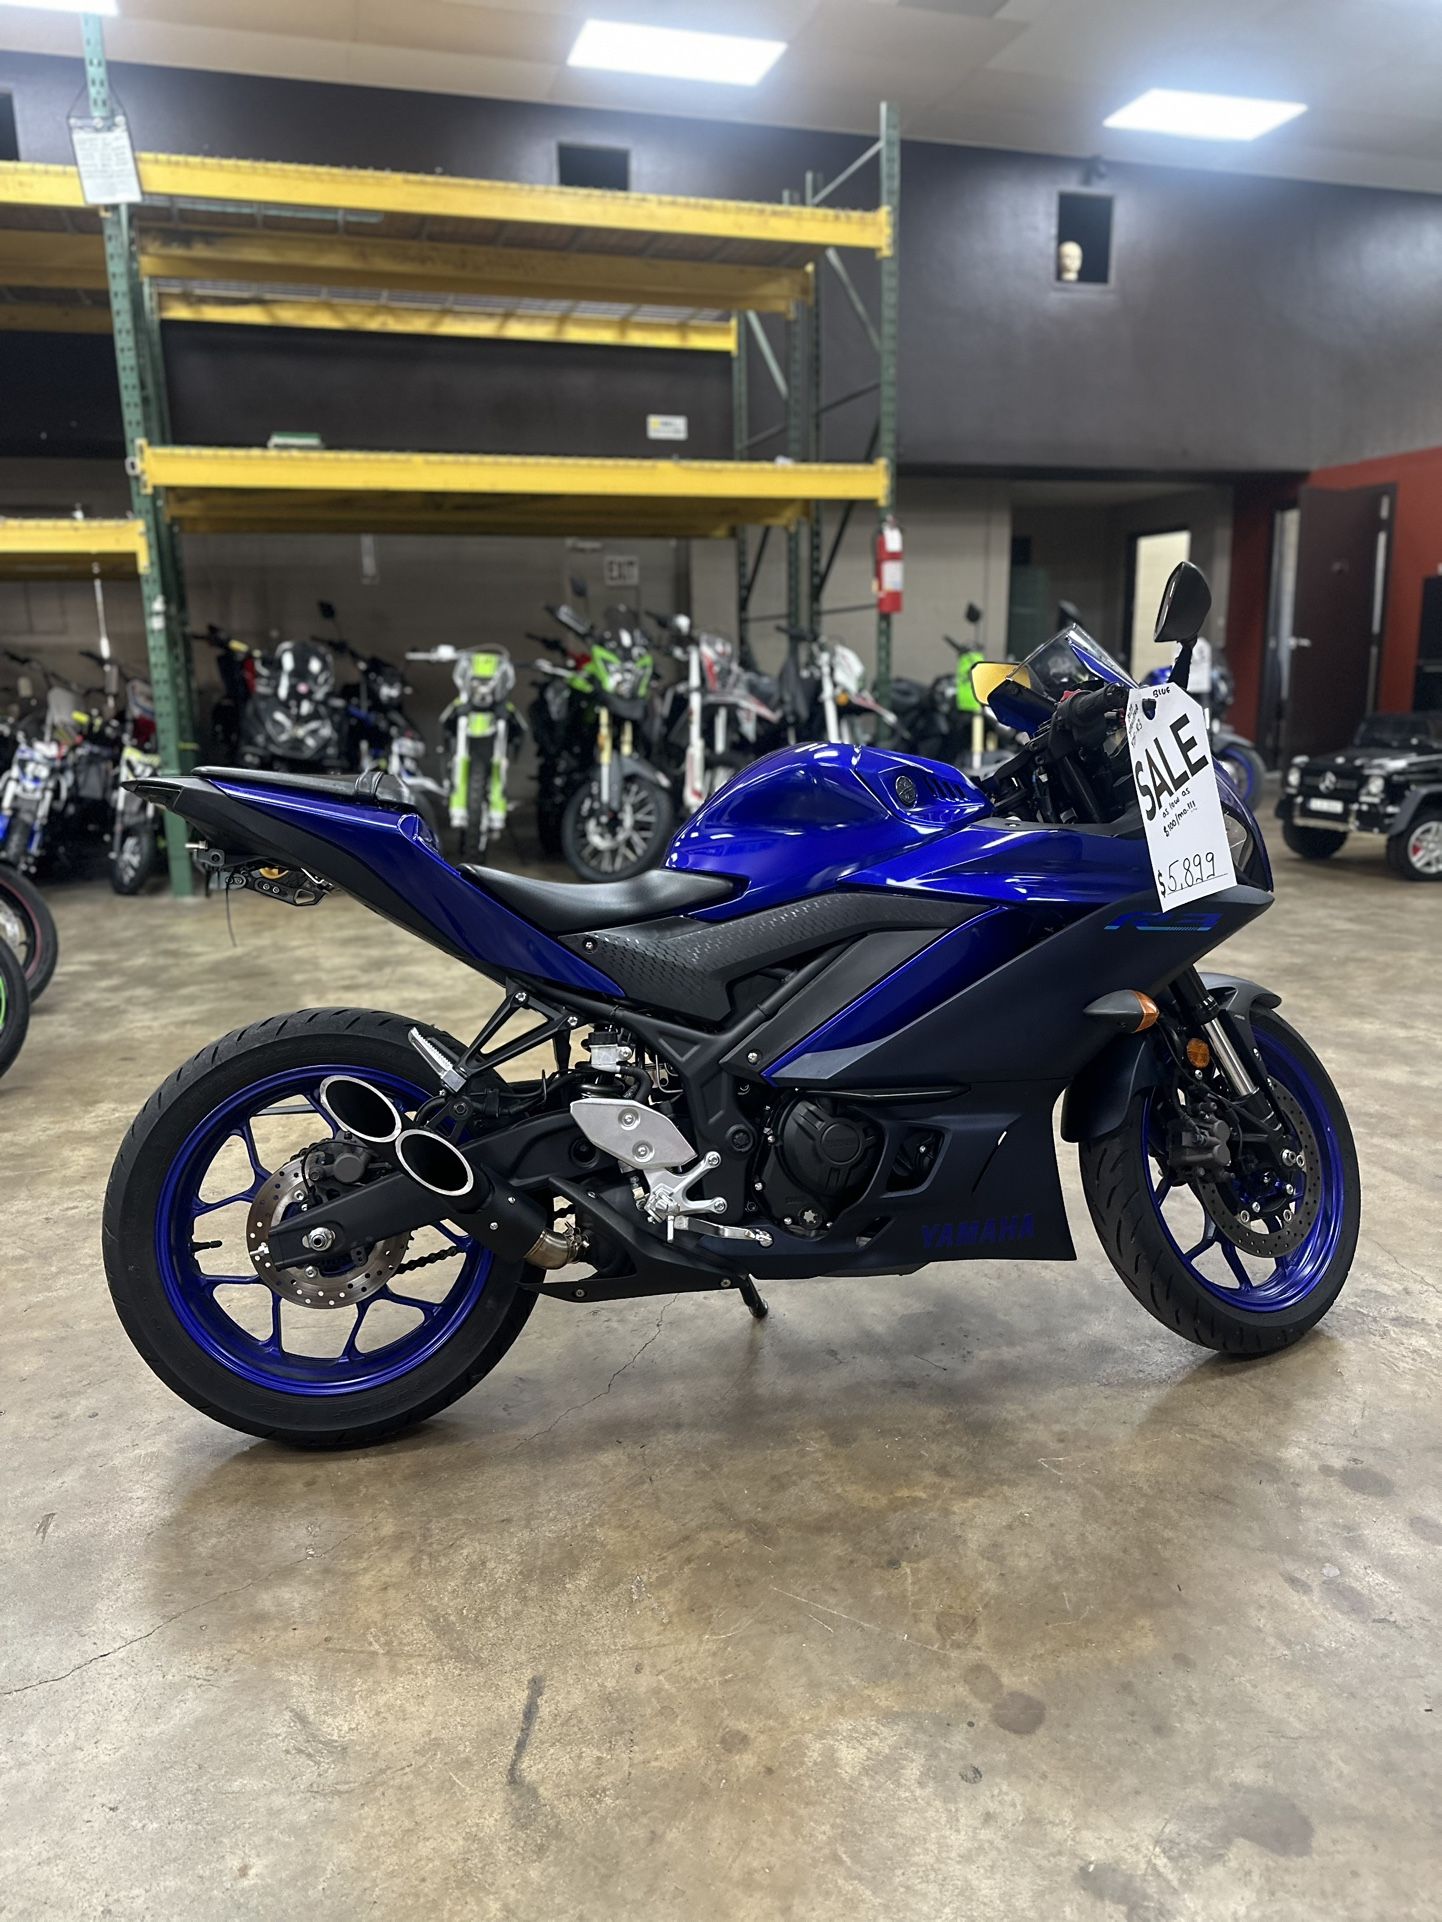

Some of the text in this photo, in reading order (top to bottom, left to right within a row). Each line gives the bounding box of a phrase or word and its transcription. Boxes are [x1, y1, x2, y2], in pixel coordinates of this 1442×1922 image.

[1134, 713, 1210, 822] SALE
[1162, 787, 1191, 818] as low as
[921, 1212, 1035, 1249] YAMAHA
